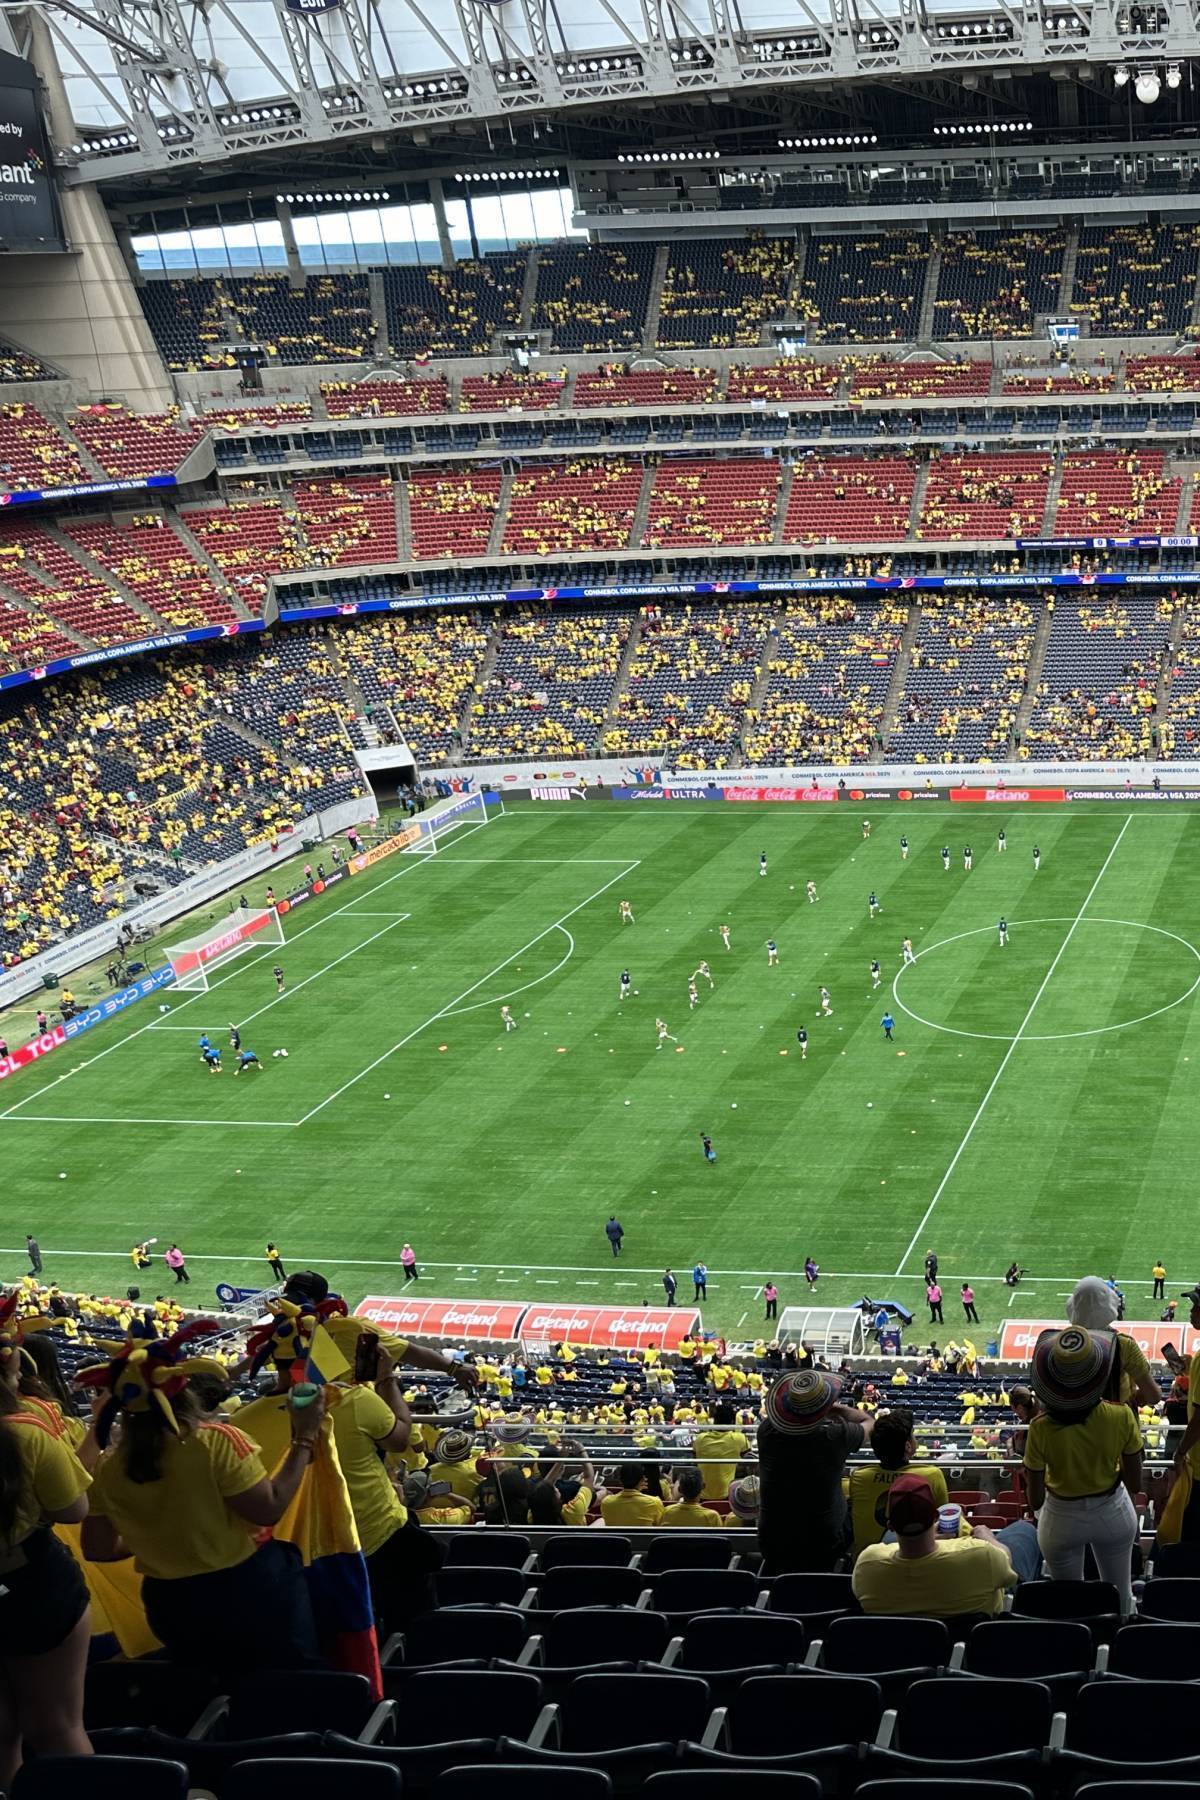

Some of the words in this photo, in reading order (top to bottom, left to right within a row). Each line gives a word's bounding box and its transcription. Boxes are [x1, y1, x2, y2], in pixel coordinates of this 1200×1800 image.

[11, 123, 22, 137] by
[0, 161, 34, 184] ant
[944, 578, 978, 586] CONMEBOL
[584, 588, 619, 596] CONMEBOL
[389, 600, 428, 608] CONMEBOL
[428, 598, 443, 606] COPA
[443, 596, 476, 604] AMERICA
[490, 593, 506, 601] 2024
[530, 788, 570, 800] PUMA
[1074, 791, 1113, 799] CONMEBOL
[1115, 791, 1131, 799] COPA
[1131, 791, 1168, 799] AMERICA
[1170, 791, 1184, 799] USA
[369, 837, 400, 862] mercado
[105, 988, 138, 1012] BYD
[66, 1010, 101, 1035] BYD
[27, 1030, 66, 1058] TCL
[364, 1309, 419, 1324] Betano
[441, 1311, 497, 1326] Betano
[531, 1316, 588, 1330] Betano
[609, 1319, 666, 1334] Betano
